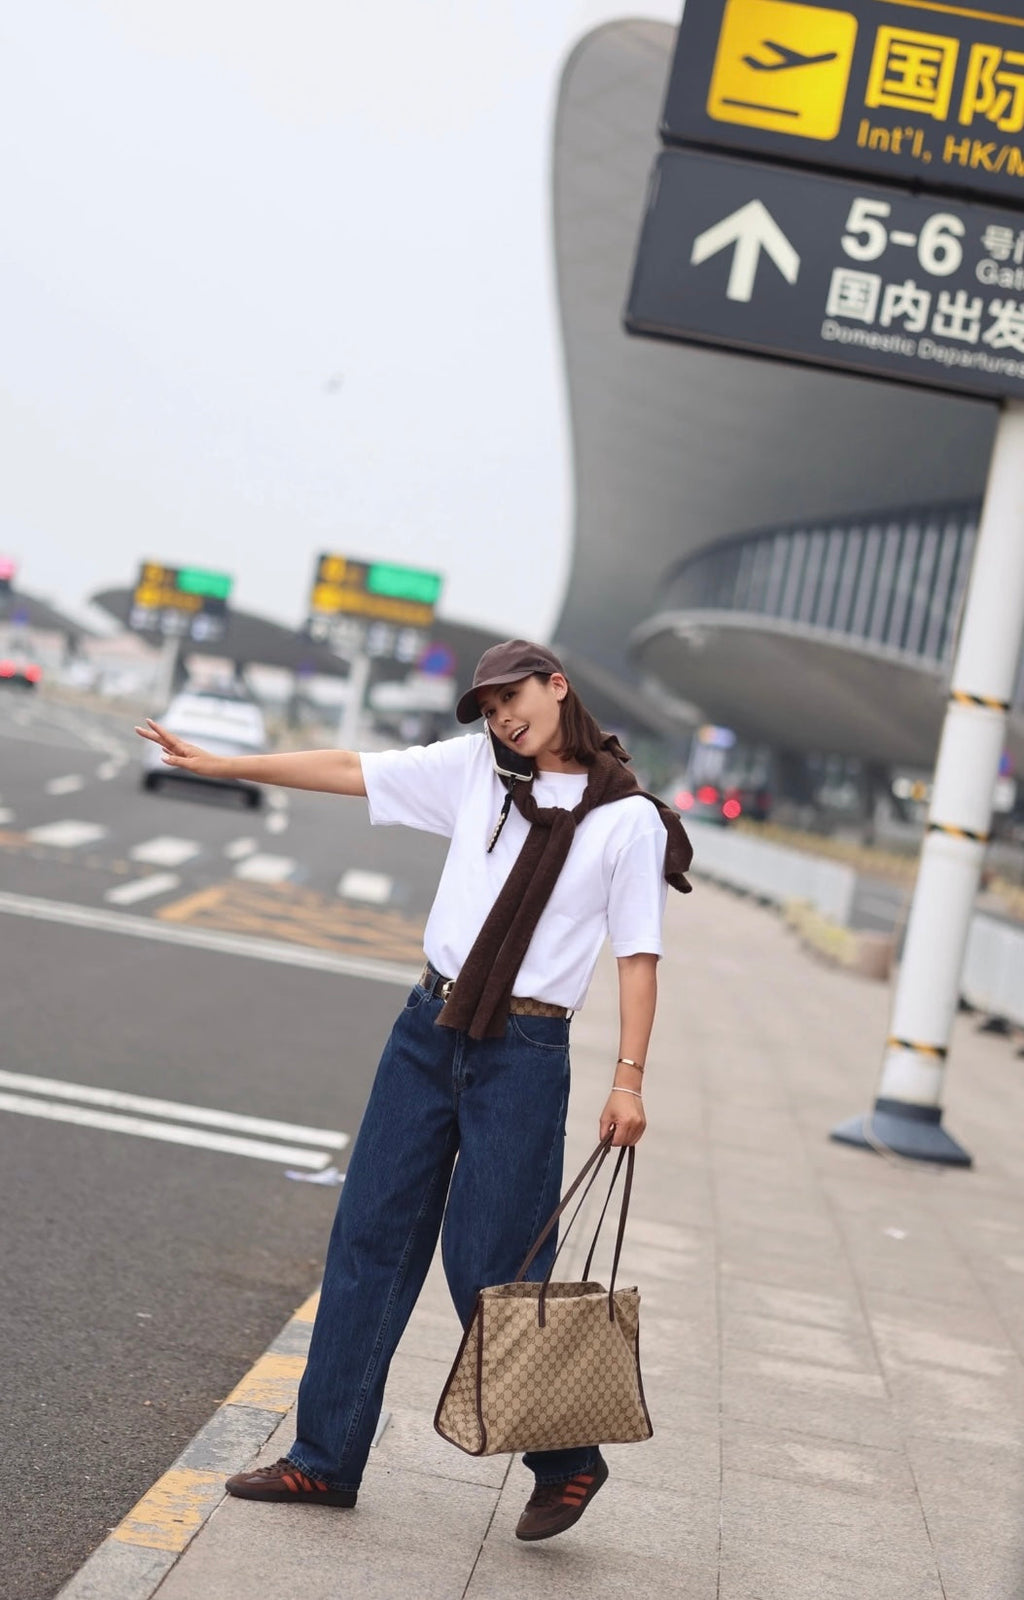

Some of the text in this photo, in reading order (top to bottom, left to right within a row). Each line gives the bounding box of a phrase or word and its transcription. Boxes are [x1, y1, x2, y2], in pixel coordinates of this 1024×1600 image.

[864, 25, 1024, 133] 国际
[841, 197, 966, 277] 5-6
[975, 258, 1024, 293] Gat
[821, 318, 1024, 379] Domestic Departures
[825, 266, 1024, 355] 国内出发
